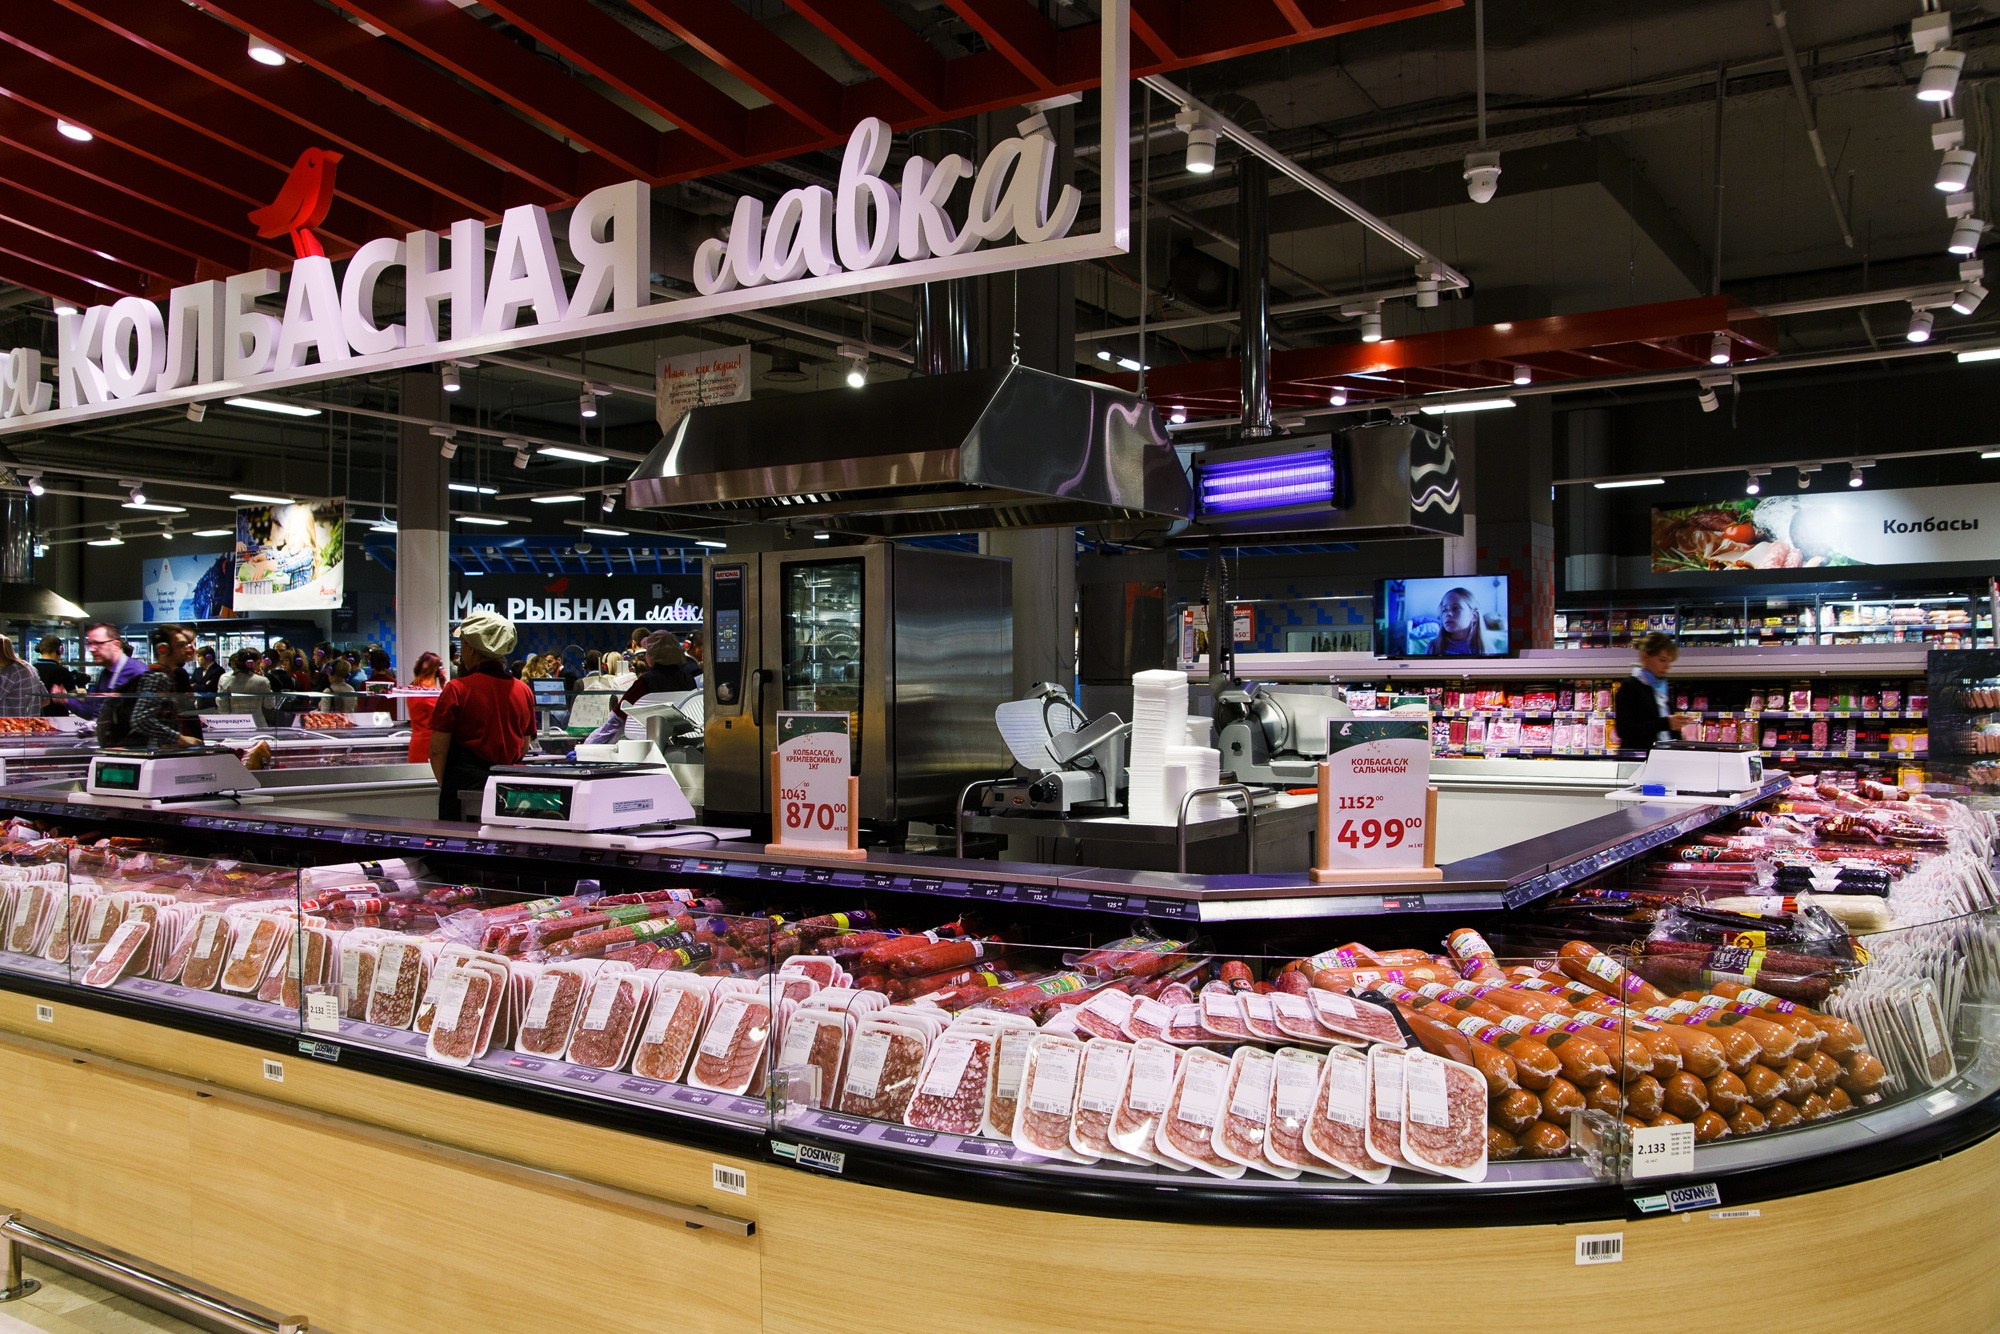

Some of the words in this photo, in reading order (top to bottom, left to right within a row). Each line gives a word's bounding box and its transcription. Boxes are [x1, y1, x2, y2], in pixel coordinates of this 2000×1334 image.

[0, 347, 53, 419] я
[58, 180, 650, 409] КОЛБАСНАЯ
[693, 117, 1082, 296] лавка
[700, 376, 733, 387] обственного
[1883, 516, 1979, 534] Колбасы
[507, 598, 635, 621] РЫБНАЯ
[793, 749, 822, 757] КОЛБАСА
[1351, 758, 1392, 766] КОЛБАСА
[1393, 757, 1409, 766] С/К
[1353, 766, 1406, 774] САЛЬЧИЧОН
[781, 788, 807, 801] 1043
[1339, 796, 1375, 809] 1152
[786, 802, 835, 830] 870
[834, 803, 847, 813] 00
[1337, 818, 1405, 849] 499
[1405, 817, 1422, 828] 00
[310, 1006, 324, 1015] 2.132
[800, 1146, 832, 1162] COSTAN
[1638, 1143, 1666, 1155] 2.133
[1670, 1186, 1706, 1203] COSTAN
